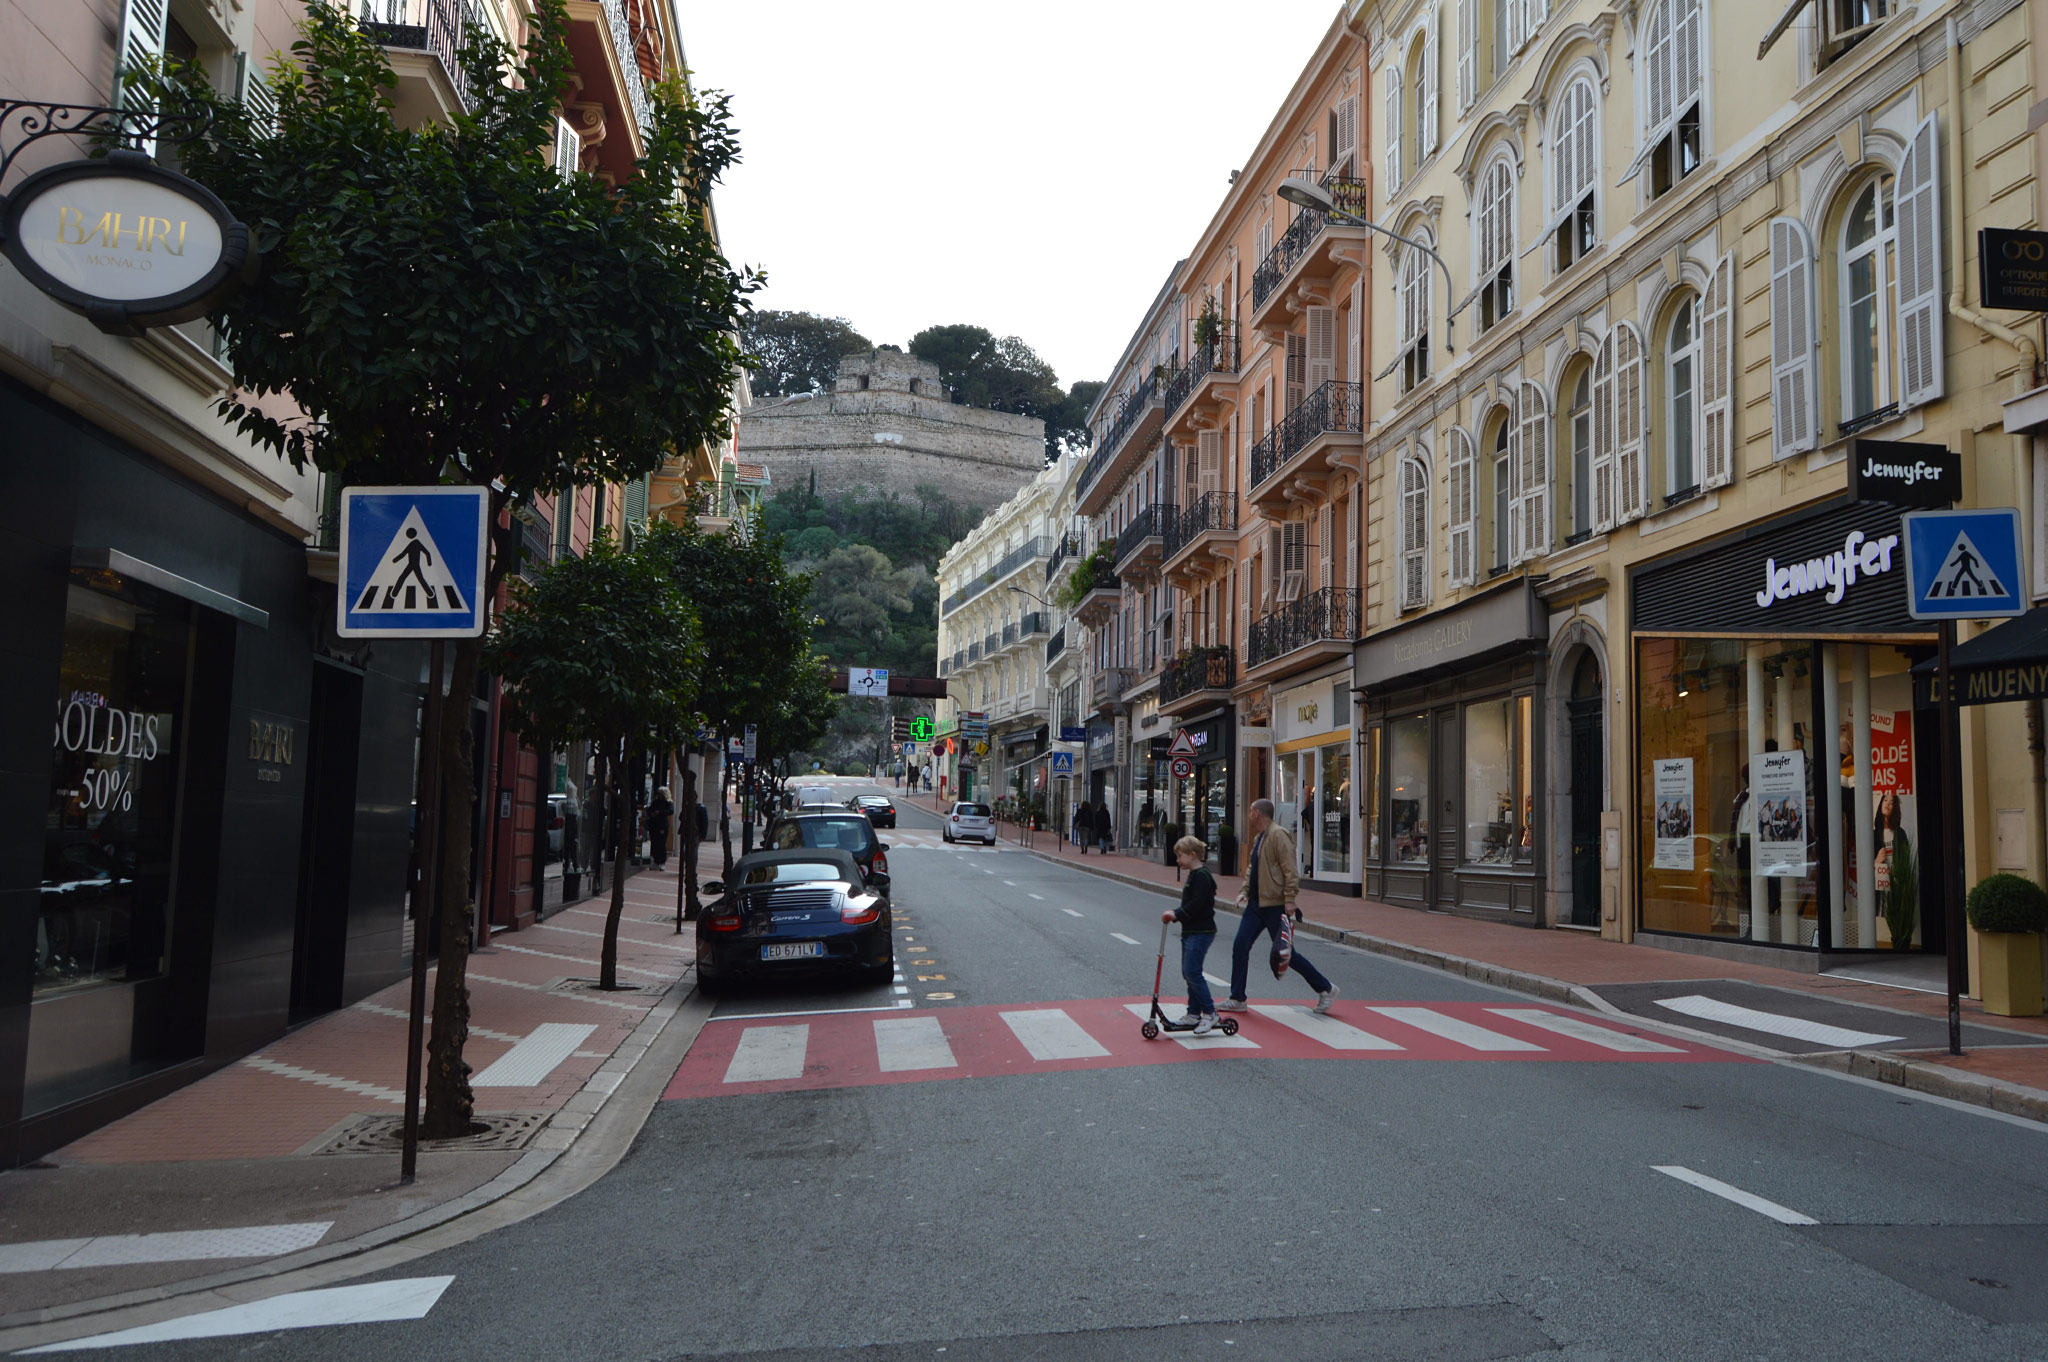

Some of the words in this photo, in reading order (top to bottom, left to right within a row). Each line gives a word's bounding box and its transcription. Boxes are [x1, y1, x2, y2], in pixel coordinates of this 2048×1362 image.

[56, 206, 189, 257] BAHRI
[86, 254, 152, 272] MONACO
[2000, 268, 2048, 282] OPTIQUE
[1862, 457, 1943, 486] Jennyfer
[1756, 530, 1898, 608] Jennyfer
[1434, 618, 1473, 652] GALLERY
[1297, 701, 1318, 724] maje
[248, 719, 295, 766] BAHRI
[1871, 739, 1909, 765] OLDÉ
[1175, 763, 1188, 773] 30
[1765, 756, 1791, 769] Jennyfer
[1872, 767, 1896, 786] AIS
[70, 768, 132, 812] -50%
[800, 913, 811, 921] S
[769, 945, 782, 957] ED
[784, 943, 815, 956] 671LV
